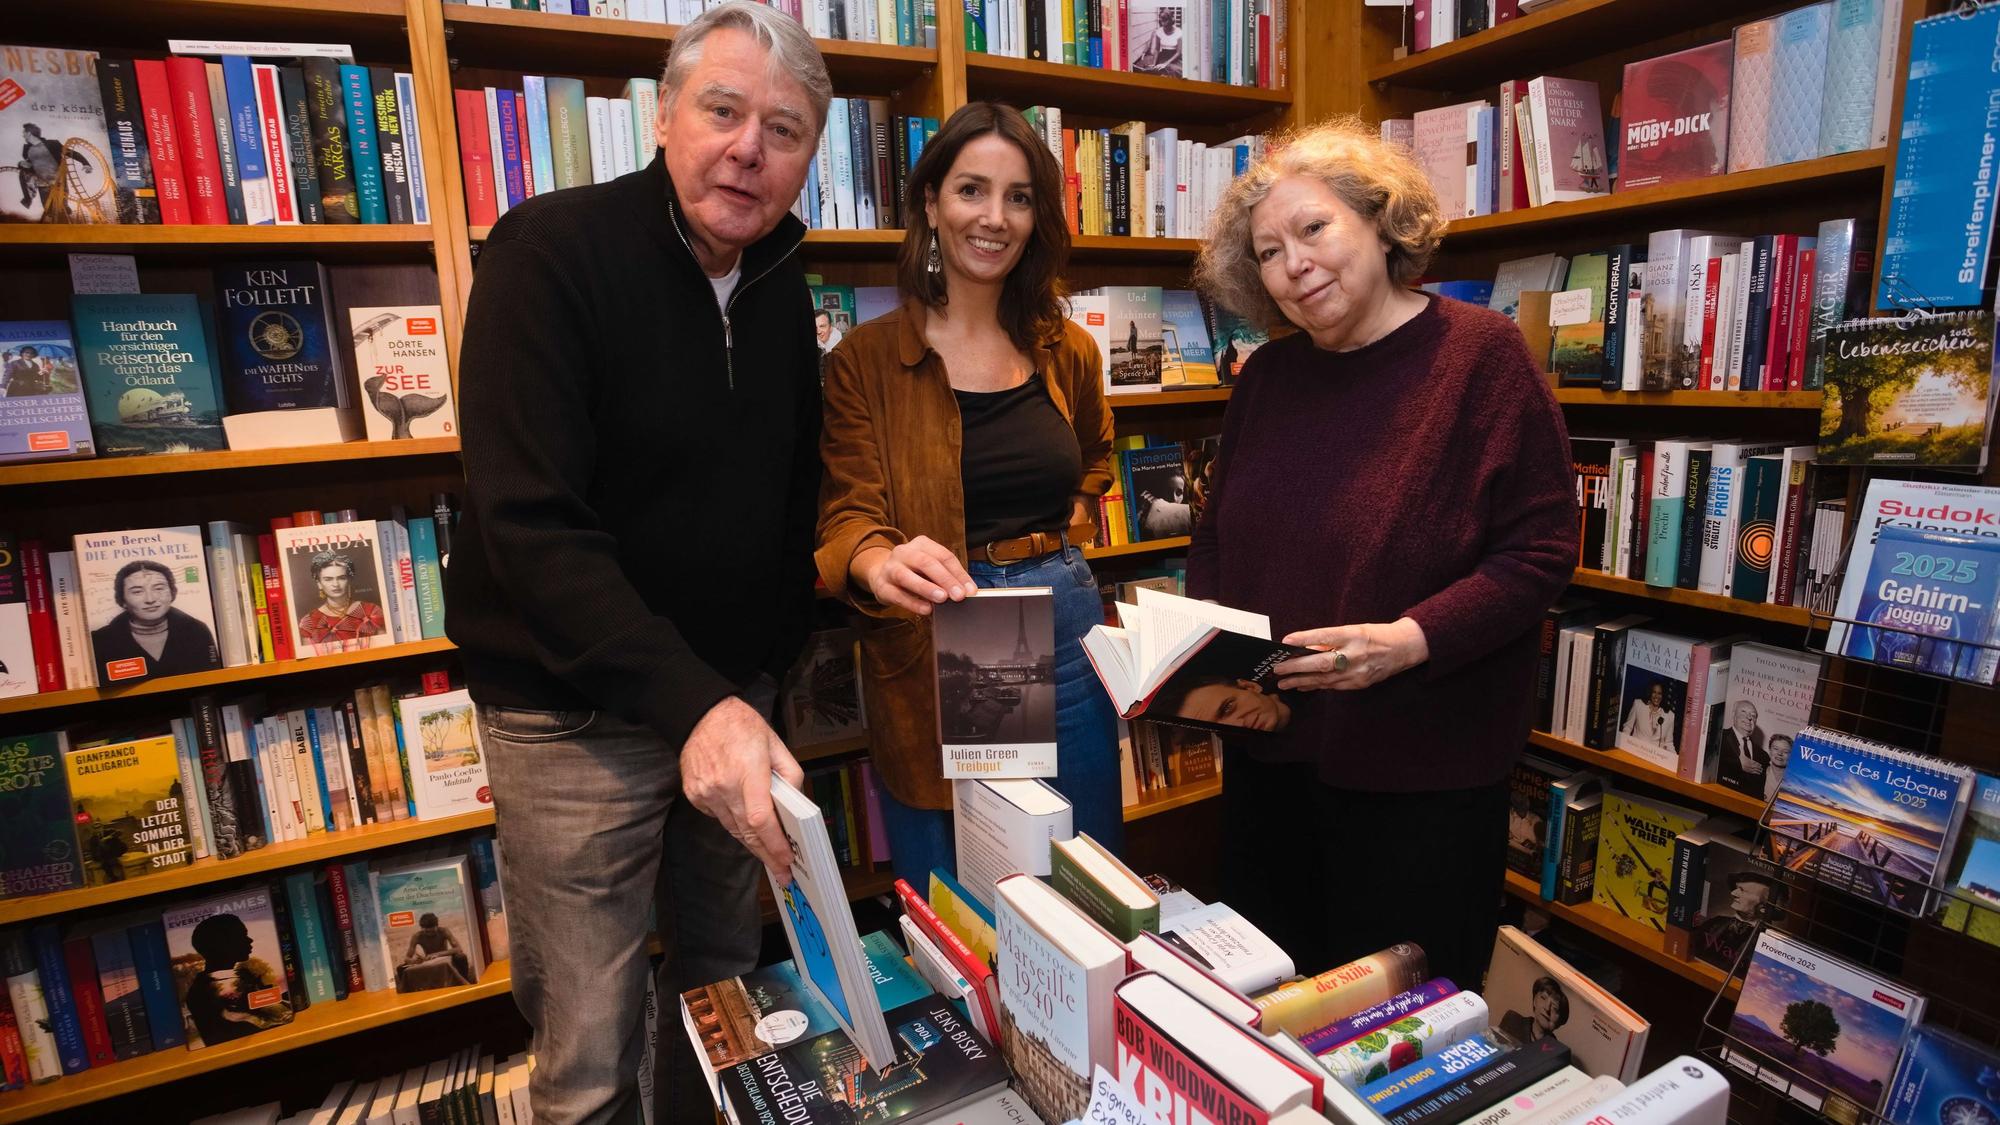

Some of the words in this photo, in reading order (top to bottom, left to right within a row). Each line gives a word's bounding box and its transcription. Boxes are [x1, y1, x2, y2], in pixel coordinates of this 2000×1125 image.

[113, 77, 126, 111] Monster
[350, 73, 366, 134] AUFRUHR
[384, 89, 395, 112] YORK
[1547, 88, 1574, 98] LONDON
[1548, 98, 1562, 107] DIE
[1565, 99, 1585, 109] REISE
[32, 101, 57, 113] der
[63, 103, 103, 116] könig
[151, 108, 159, 120] den
[1549, 107, 1565, 117] MIT
[1566, 109, 1582, 118] DER
[268, 118, 278, 139] GRAB
[387, 114, 399, 135] NEW
[503, 100, 517, 161] BLUTBUCH
[1550, 117, 1577, 127] SNARK
[1627, 112, 1711, 145] MOBY-DICK
[117, 121, 136, 157] NEUHAUS
[153, 130, 163, 146] Dorf
[219, 118, 231, 153] ALENTEJO
[289, 114, 305, 164] SELLANO
[156, 147, 165, 160] Das
[225, 154, 232, 162] IM
[272, 140, 283, 177] DOPPELTE
[322, 147, 333, 166] Fred
[328, 126, 346, 180] VARGAS
[360, 142, 369, 155] IN
[127, 162, 141, 181] NELE
[383, 153, 394, 171] DON
[391, 142, 406, 183] WINSLOW
[227, 164, 235, 186] RACHE
[276, 178, 286, 193] DAS
[298, 167, 310, 190] LUIS
[523, 159, 533, 192] HORNBY
[163, 178, 172, 199] LOUISE
[171, 178, 179, 199] PENNY
[197, 176, 205, 197] LOUISE
[204, 176, 212, 197] PENNY
[368, 166, 379, 207] VESPER
[1958, 133, 1995, 283] Streifenplaner
[246, 269, 287, 286] KEN
[1648, 262, 1675, 272] GLANZ
[1690, 262, 1702, 293] 1848
[1757, 249, 1767, 293] ÜBERSTANDEN?
[225, 285, 314, 308] FOLLETT
[1128, 292, 1147, 303] Und
[1609, 254, 1621, 324] MACHTVERFALL
[1800, 273, 1809, 303] TOLERANZ
[1816, 271, 1838, 340] WAGER
[102, 320, 177, 332] Handbuch
[120, 332, 137, 341] für
[140, 332, 163, 341] den
[1949, 328, 1974, 337] 2025
[109, 341, 178, 352] vorsichtigen
[388, 340, 423, 349] DÖRTE
[393, 347, 436, 358] HANSEN
[1183, 348, 1206, 357] MEER
[1840, 335, 1976, 359] Lebenszeichen
[97, 351, 194, 365] Reisenden
[1128, 362, 1147, 370] Laura
[114, 364, 156, 375] durch
[162, 363, 182, 374] das
[245, 367, 258, 375] DIE
[258, 364, 303, 375] WAFFEN
[263, 372, 304, 384] LICHTS
[375, 365, 404, 375] ZUR
[125, 374, 175, 386] Ödland
[386, 374, 431, 390] SEE
[12, 404, 82, 416] SCHLECHTER
[1131, 452, 1181, 465] Simenon
[1687, 458, 1700, 509] ANGEZÄHLT
[1713, 467, 1732, 517] PROFITS
[1788, 494, 1798, 511] Glück
[1878, 499, 2000, 525] Sudok
[1658, 513, 1669, 539] Precht
[1704, 519, 1712, 547] JOSEPH
[1710, 520, 1721, 550] STIGLITZ
[84, 537, 116, 550] Anne
[121, 534, 162, 546] Berest
[289, 531, 369, 554] FRIDA
[1784, 526, 1794, 548] braucht
[85, 550, 111, 562] DIE
[114, 543, 190, 559] POSTKARTE
[1782, 549, 1791, 568] Zeiten
[418, 555, 428, 581] BOYD
[1890, 552, 1979, 584] 2025
[59, 577, 67, 600] SORTEN
[1779, 569, 1789, 594] schweren
[421, 582, 433, 623] WILLIAM
[1878, 580, 1982, 613] Gehirn-
[62, 601, 70, 615] ALTE
[1885, 604, 1952, 629] jogging
[1631, 636, 1694, 662] KAMALA
[1254, 649, 1284, 673] ALEXEJ
[1632, 648, 1688, 674] HARRIS
[1742, 687, 1810, 711] HITCHCOCK
[295, 726, 306, 754] BABEL
[75, 746, 136, 765] GIANFRANCO
[950, 748, 982, 761] Julien
[986, 748, 1018, 760] Green
[77, 756, 140, 776] CALLIGARICH
[429, 772, 453, 782] Paulo
[455, 767, 482, 778] Coelho
[955, 761, 1003, 774] Treibgut
[1799, 745, 1844, 771] Worte
[1849, 761, 1881, 780] des
[1884, 771, 1948, 801] Lebens
[443, 776, 472, 787] Maktub
[156, 797, 178, 812] DER
[1892, 791, 1927, 809] 2025
[141, 811, 181, 828] LETZTE
[1624, 815, 1676, 840] WALTER
[133, 824, 183, 843] SOMMER
[1630, 826, 1668, 848] TRIER
[147, 842, 160, 854] IN
[162, 839, 185, 853] DER
[153, 851, 186, 868] STADT
[332, 869, 345, 894] ARNO
[214, 894, 268, 913] JAMES
[336, 894, 349, 925] GEIGER
[998, 914, 1075, 1008] Marseille
[1761, 940, 1796, 964] Provence
[1797, 958, 1816, 972] 2025
[1316, 976, 1337, 994] der
[1338, 964, 1374, 985] Stille
[1016, 963, 1054, 1020] 1940
[929, 1007, 956, 1033] JENS
[951, 1025, 988, 1062] BISKY
[1438, 1038, 1482, 1061] NOAH
[1442, 1043, 1498, 1074] TREVOR
[1116, 1007, 1145, 1055] BOB
[1149, 1038, 1258, 1125] WOODWARD
[1399, 1080, 1406, 1089] A
[1406, 1067, 1436, 1088] BORN
[797, 1080, 823, 1101] DIE
[1367, 1085, 1398, 1104] CRIME
[1635, 1079, 1679, 1106] Manfred
[1612, 1100, 1635, 1119] Lütz
